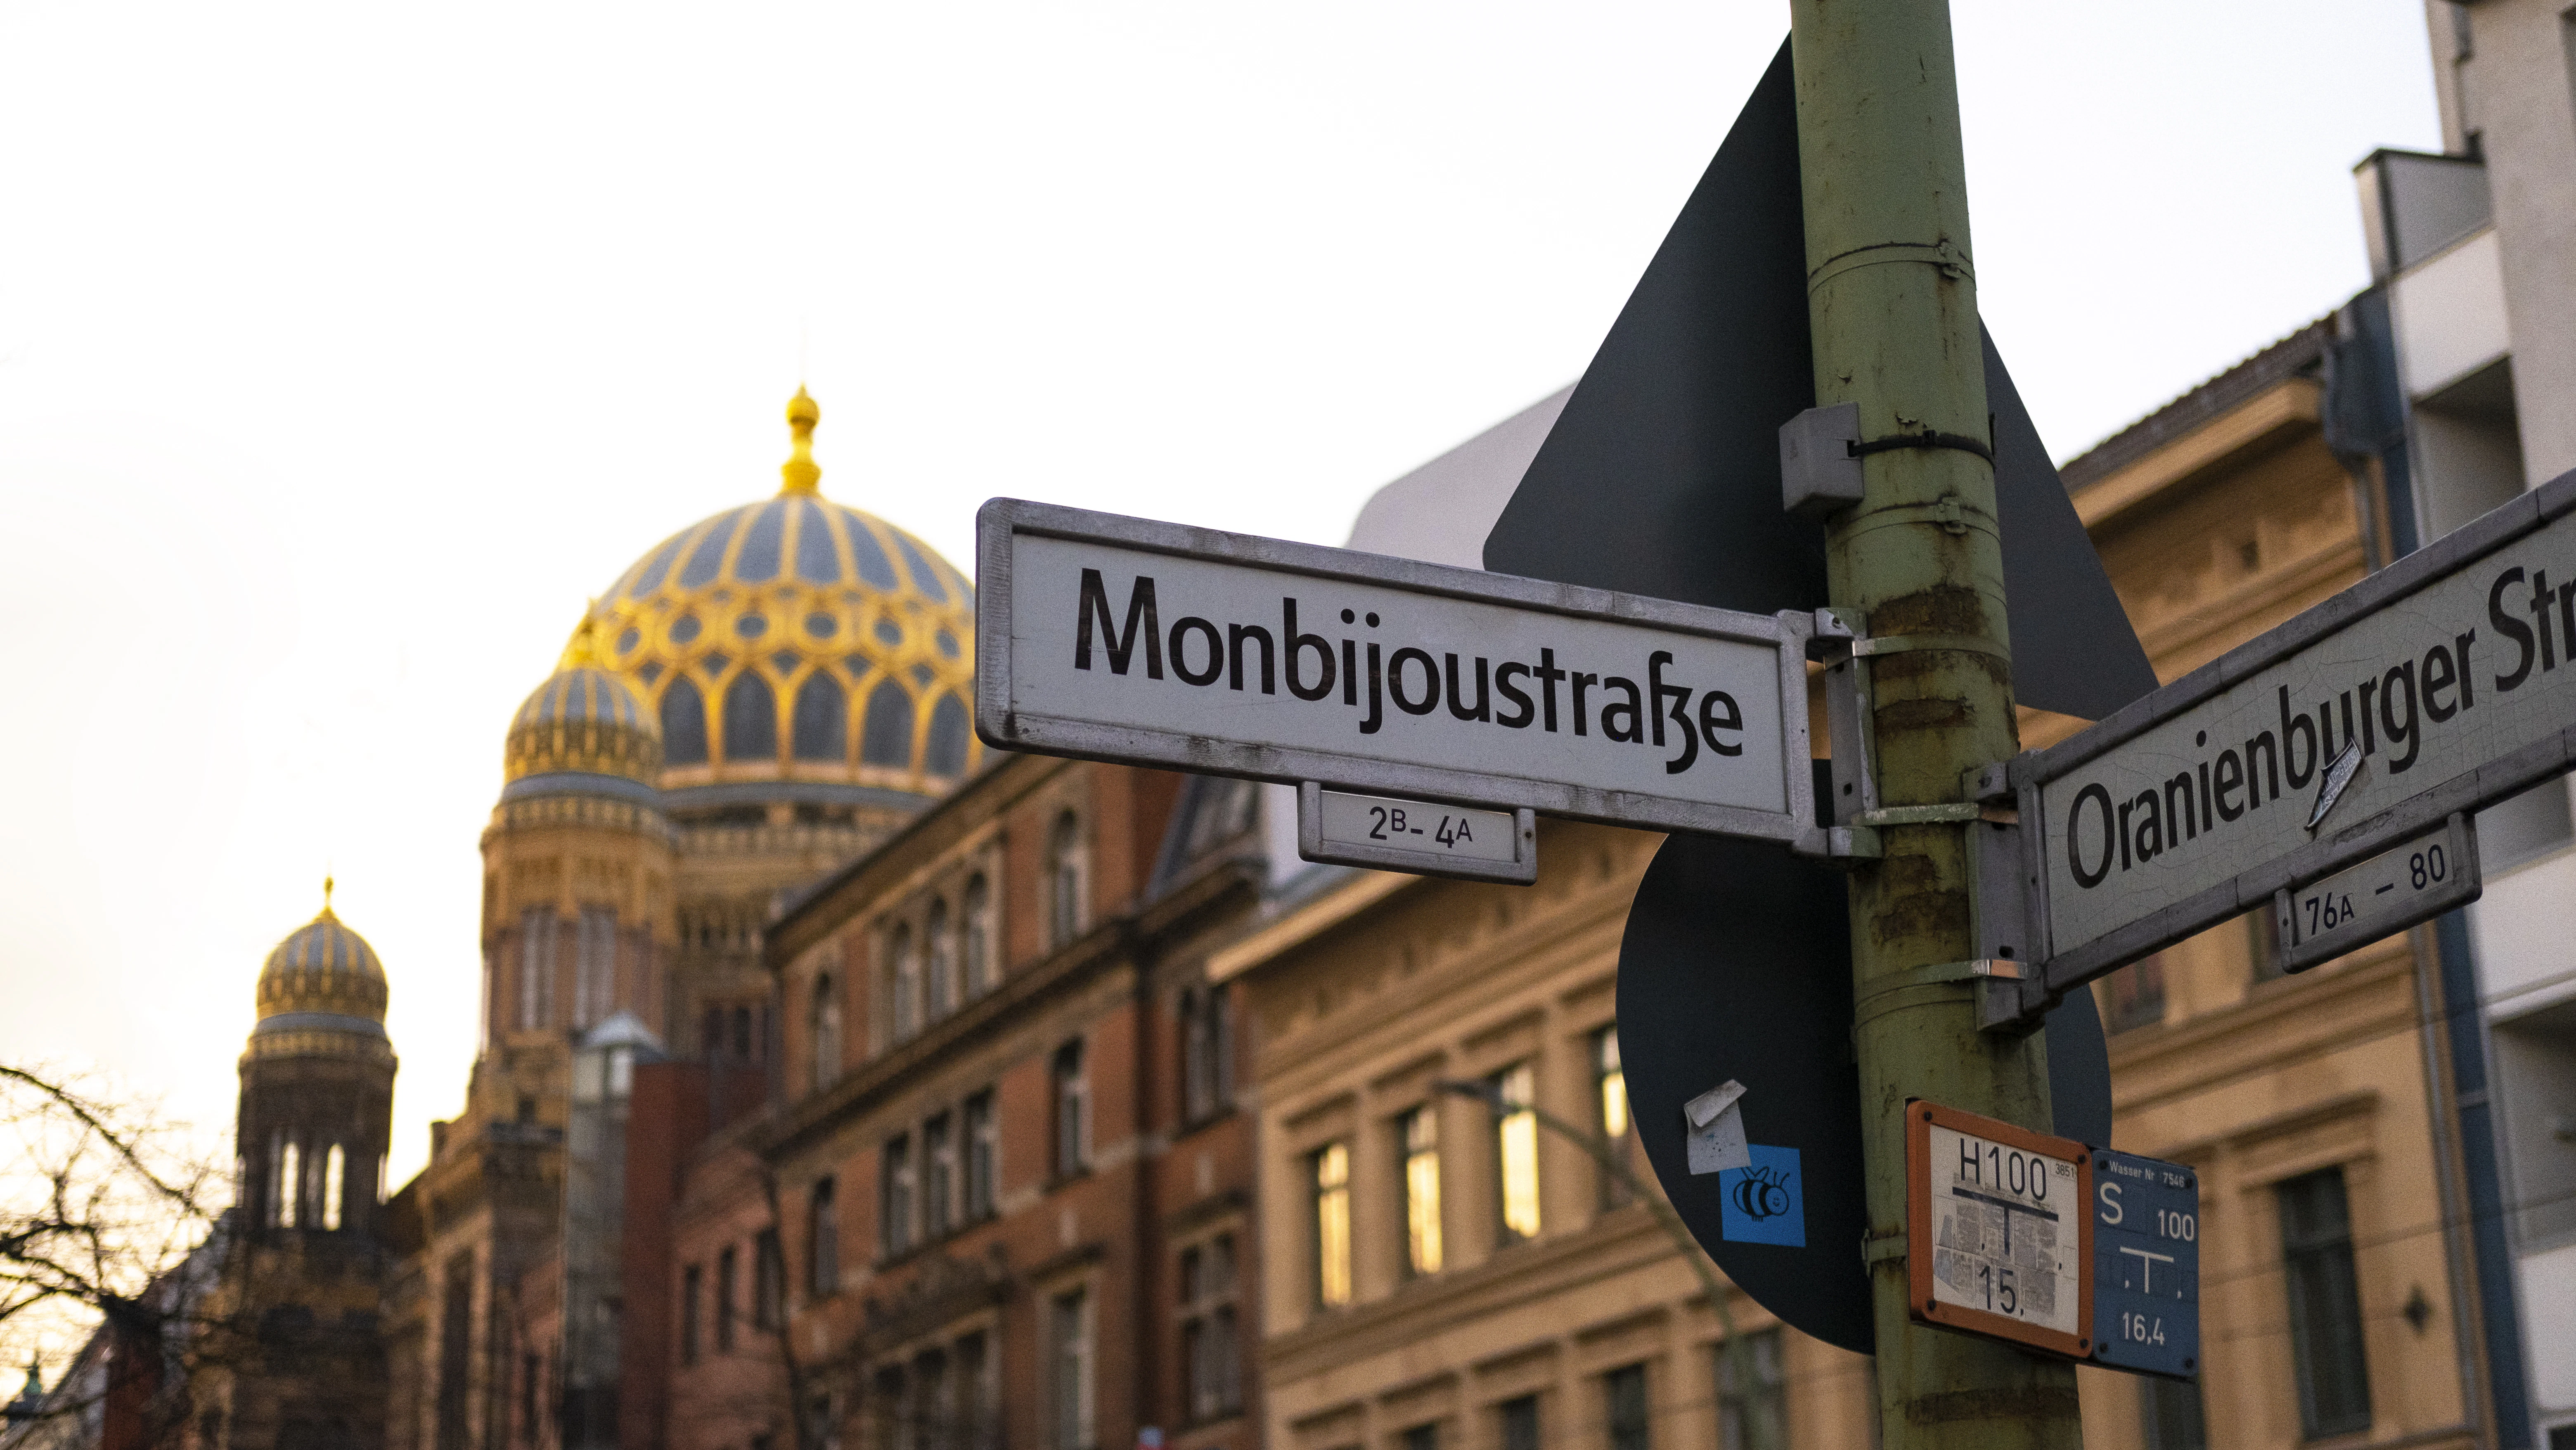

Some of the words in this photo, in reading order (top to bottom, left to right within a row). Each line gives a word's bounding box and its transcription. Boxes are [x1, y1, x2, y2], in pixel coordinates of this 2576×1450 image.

[1074, 568, 1743, 775] Monbijoustraße
[2067, 628, 2475, 889] Oranienburger
[2305, 892, 2355, 936] 76A
[2410, 844, 2446, 890] 80
[1960, 1138, 2046, 1201] H100
[2055, 1163, 2074, 1178] 3851
[2109, 1160, 2142, 1178] Wasser
[2145, 1168, 2155, 1181] Nr
[2100, 1182, 2123, 1225] S
[2158, 1210, 2194, 1241] 100
[2122, 1312, 2165, 1346] 16,4
